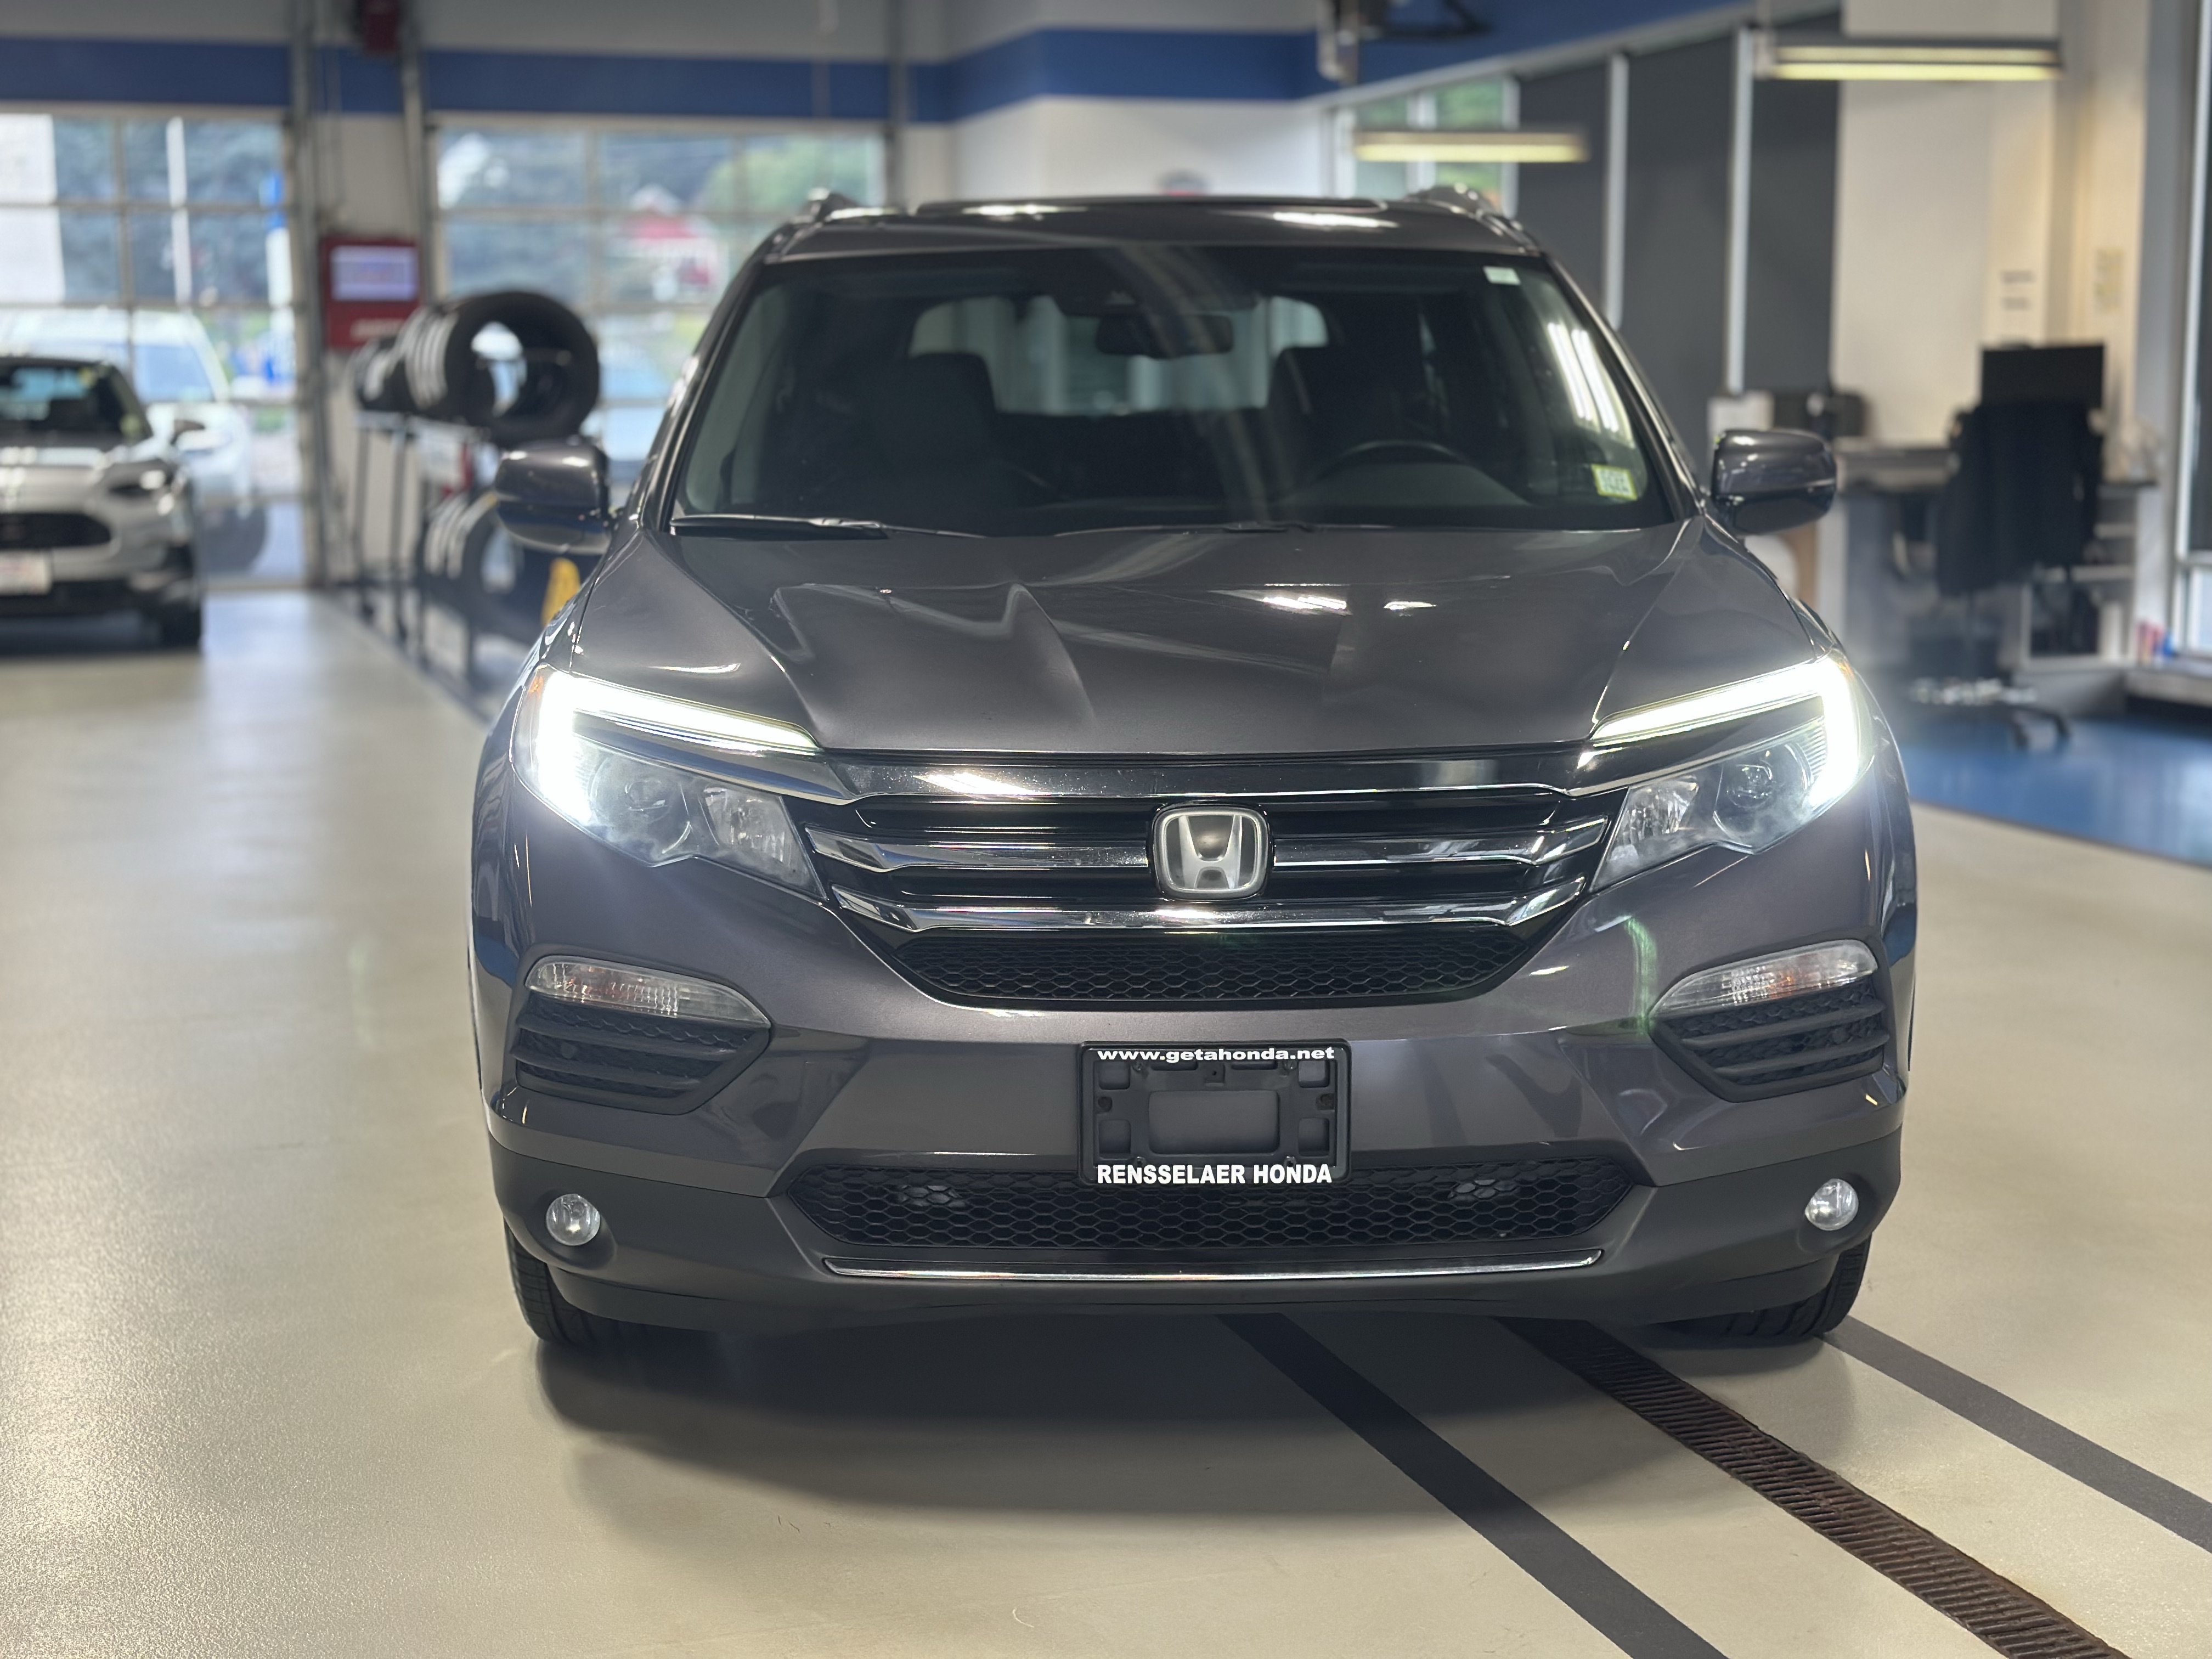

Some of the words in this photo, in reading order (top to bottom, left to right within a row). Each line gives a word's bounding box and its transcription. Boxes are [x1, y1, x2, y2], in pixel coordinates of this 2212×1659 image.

[1097, 1047, 1335, 1063] www.getahonda.net
[1097, 1164, 1246, 1184] RENSSELAER
[1253, 1164, 1333, 1184] HONDA
